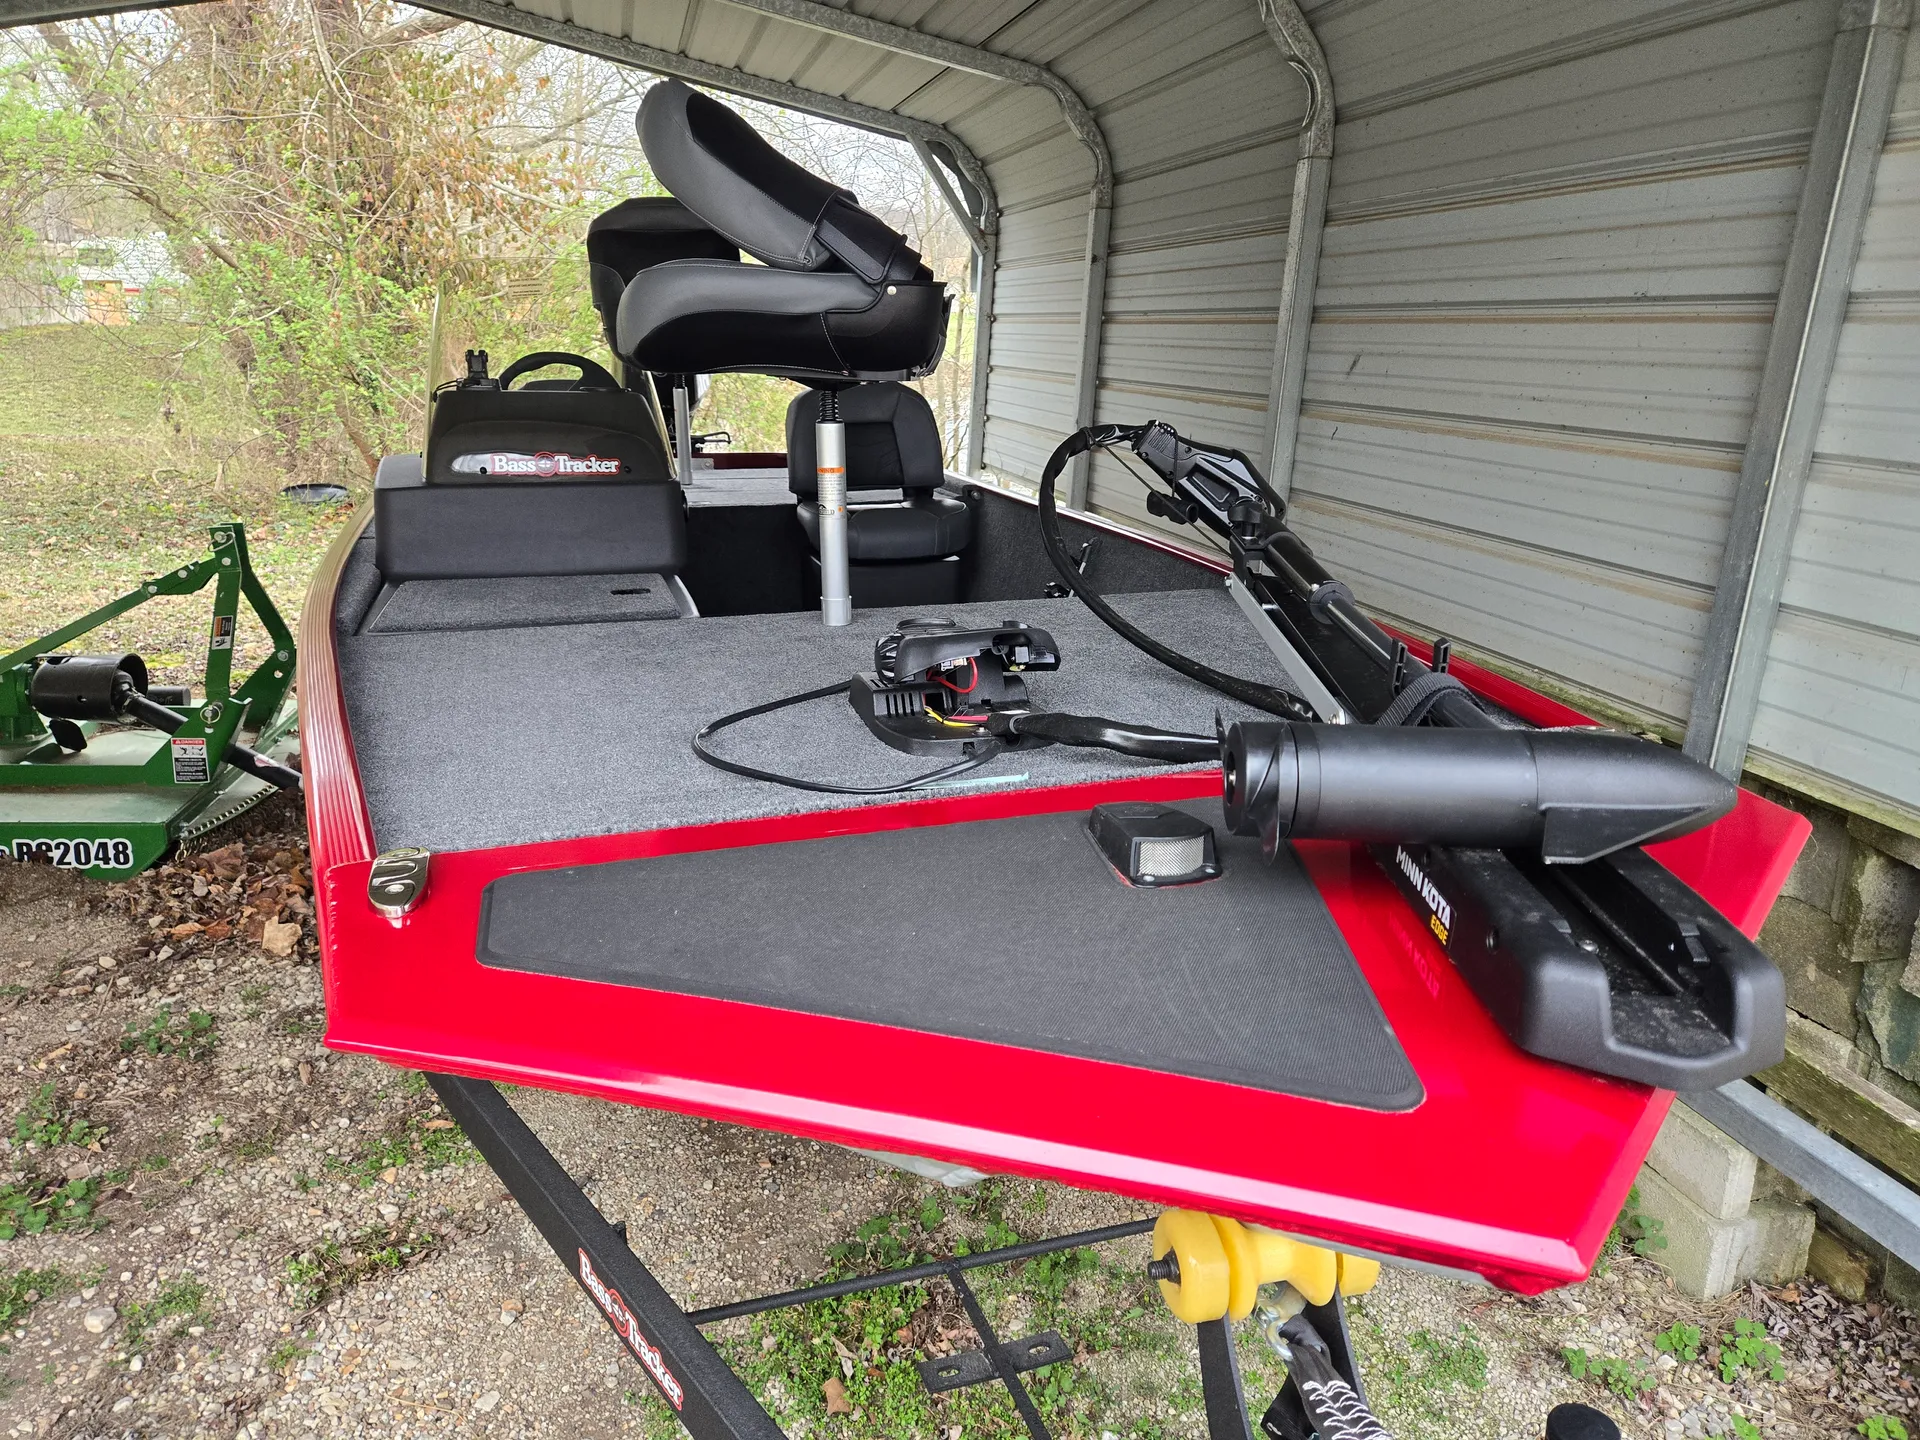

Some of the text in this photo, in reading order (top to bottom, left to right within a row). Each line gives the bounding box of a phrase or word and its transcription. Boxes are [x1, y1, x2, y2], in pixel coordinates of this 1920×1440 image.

[493, 454, 619, 473] Bass Tracker
[1395, 845, 1424, 892] MINN
[1421, 877, 1451, 930] KOTA
[1430, 914, 1449, 946] EDGE
[579, 1252, 682, 1405] Bass Tracker
